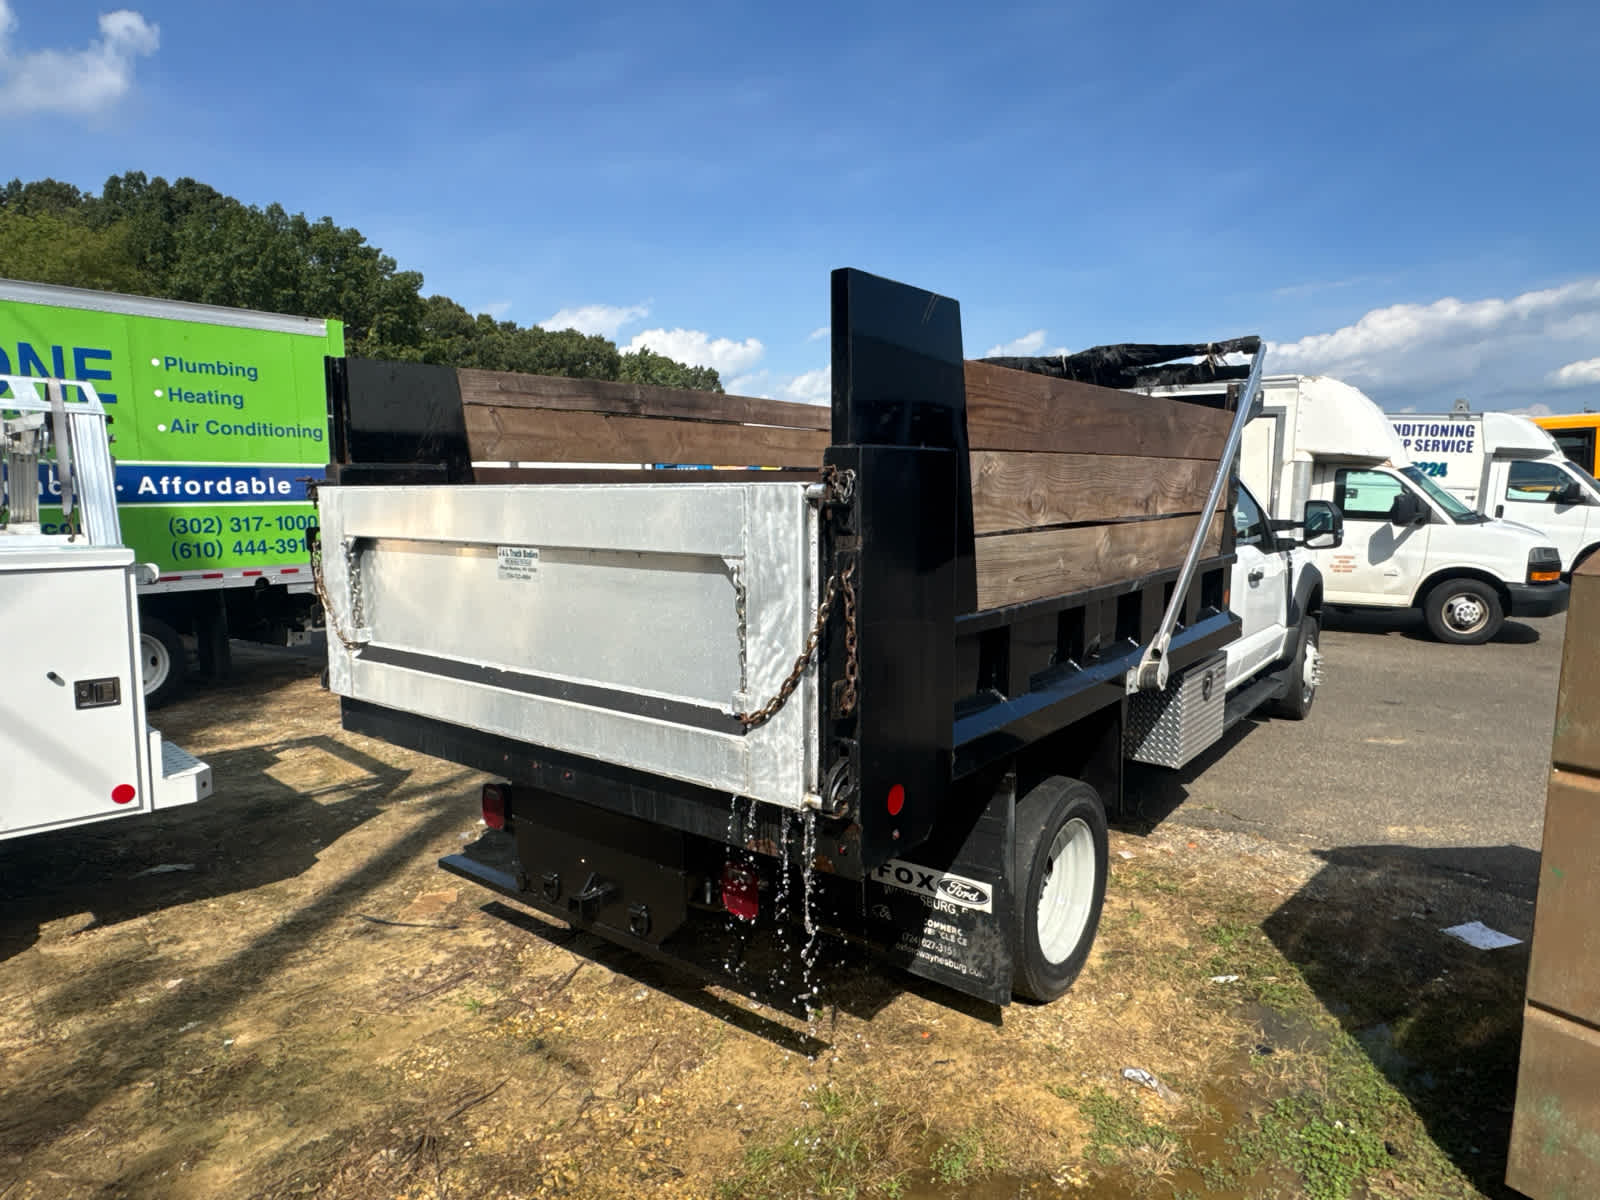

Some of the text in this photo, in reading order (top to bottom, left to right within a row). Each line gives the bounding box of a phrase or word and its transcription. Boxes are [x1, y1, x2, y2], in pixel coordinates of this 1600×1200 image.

[0, 342, 117, 414] NE
[164, 356, 259, 382] Plumbing
[168, 387, 244, 409] Heating
[170, 419, 324, 442] Air Conditioning
[1414, 439, 1474, 453] SERVICE
[137, 476, 292, 496] Affordable
[168, 515, 222, 537] (302)
[171, 538, 306, 561] (610) 444-391
[878, 863, 936, 892] FOX
